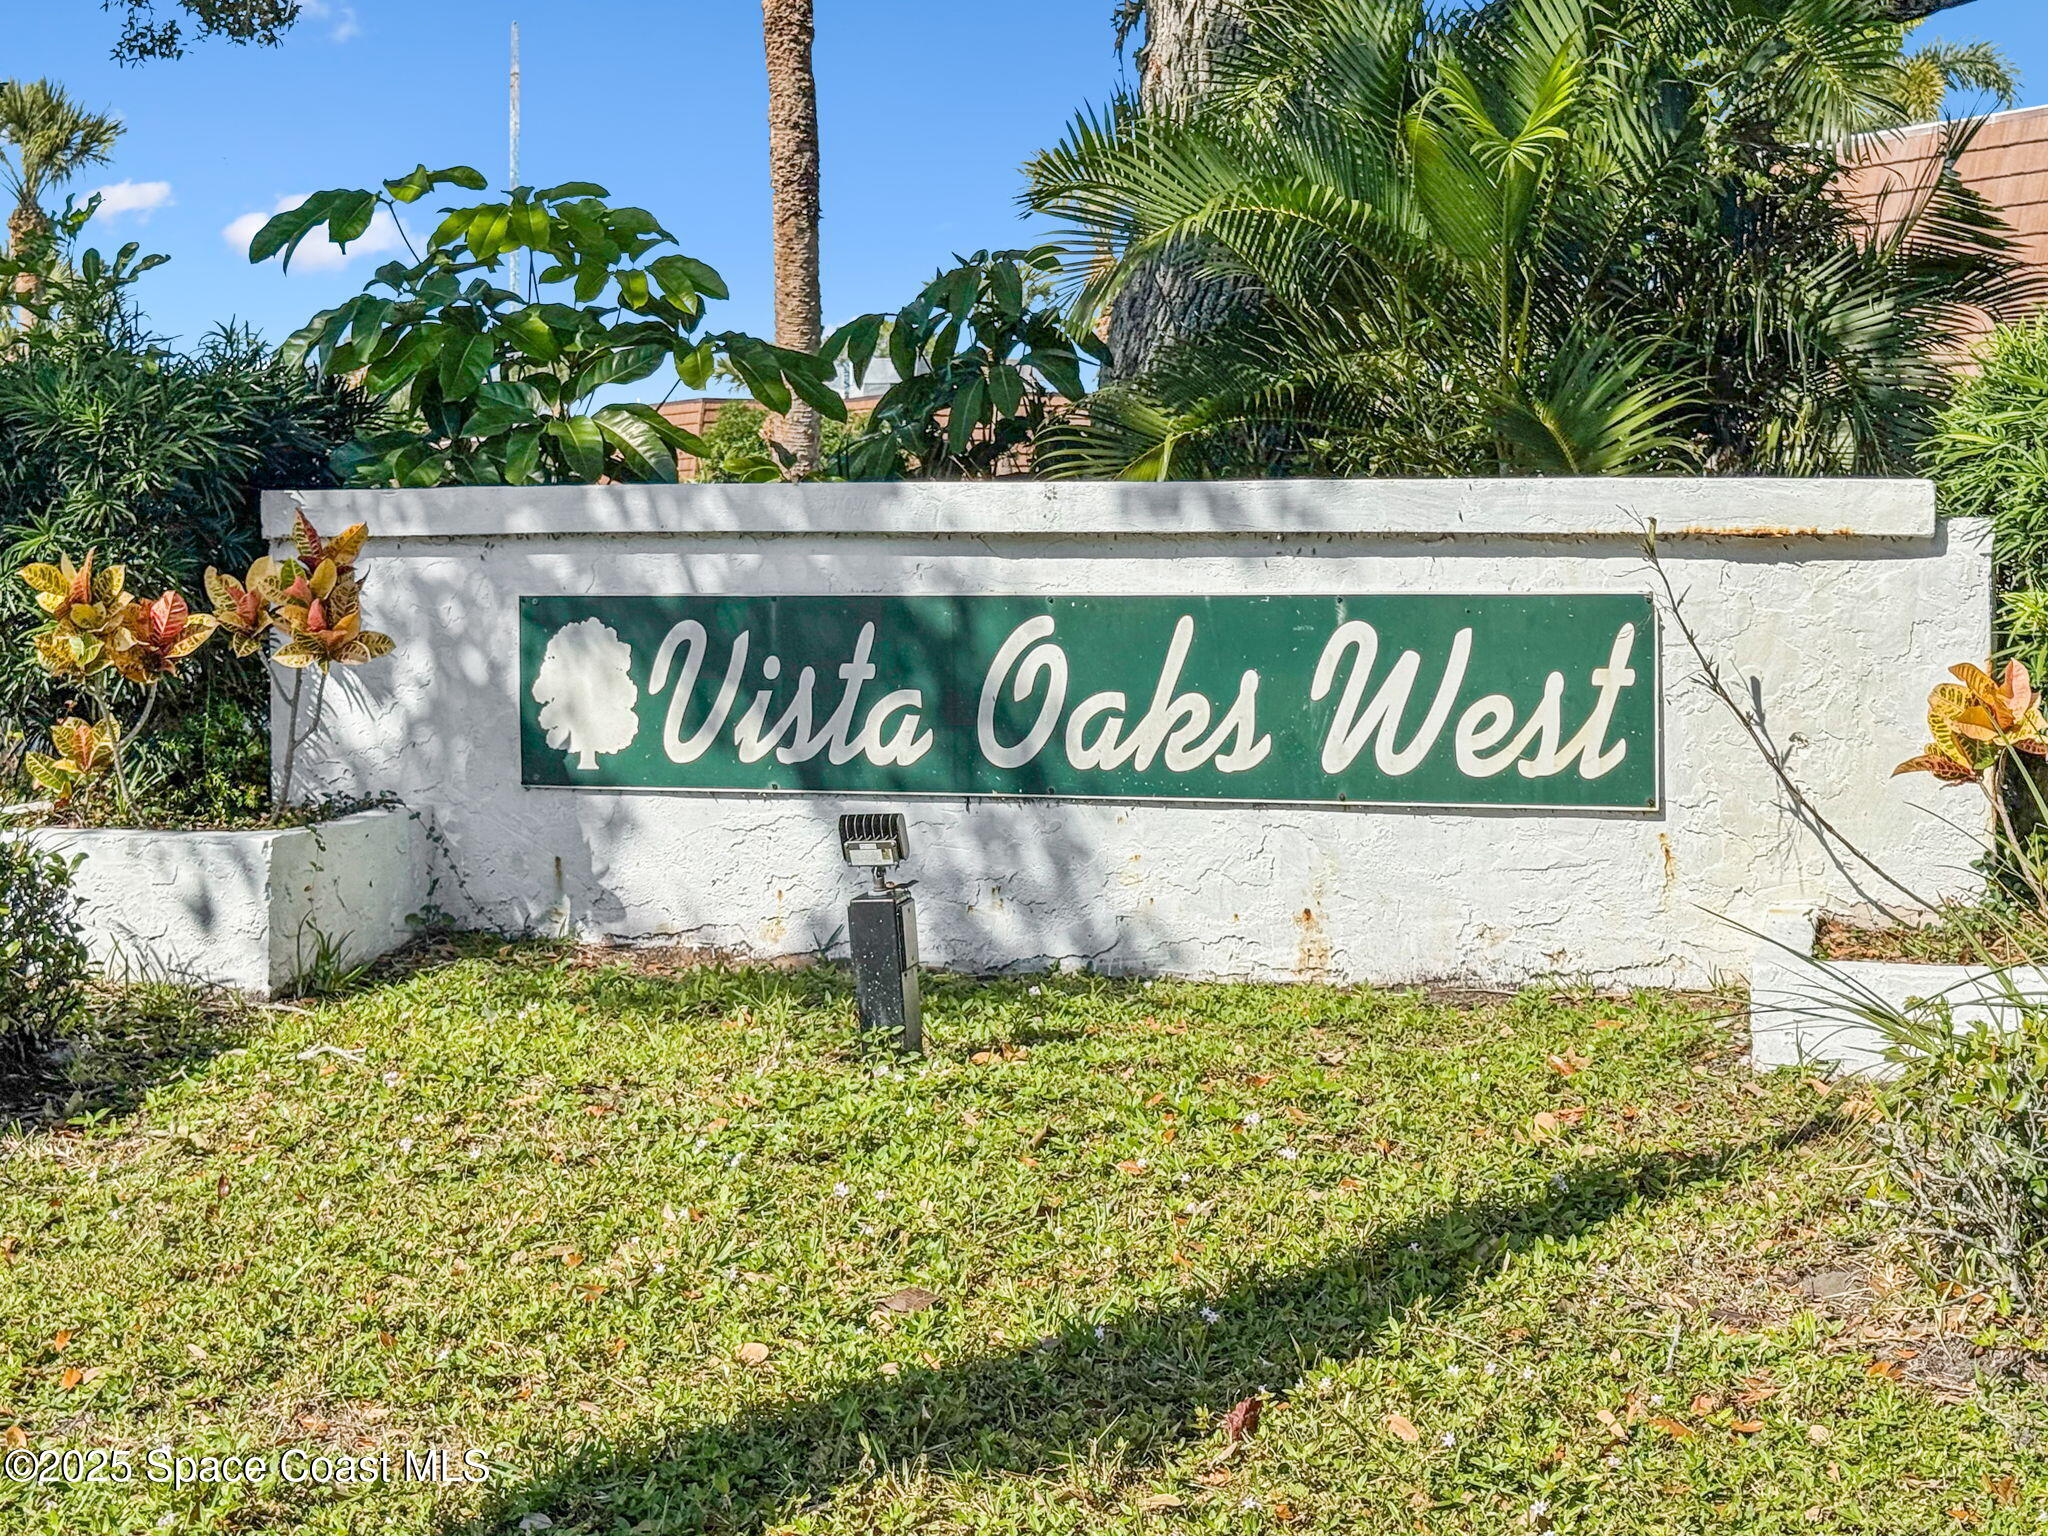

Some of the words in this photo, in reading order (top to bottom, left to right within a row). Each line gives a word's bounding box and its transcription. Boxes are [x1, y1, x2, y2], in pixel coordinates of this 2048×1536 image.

[648, 619, 934, 768] Vista
[977, 613, 1273, 776] Oaks
[1310, 619, 1638, 782] West
